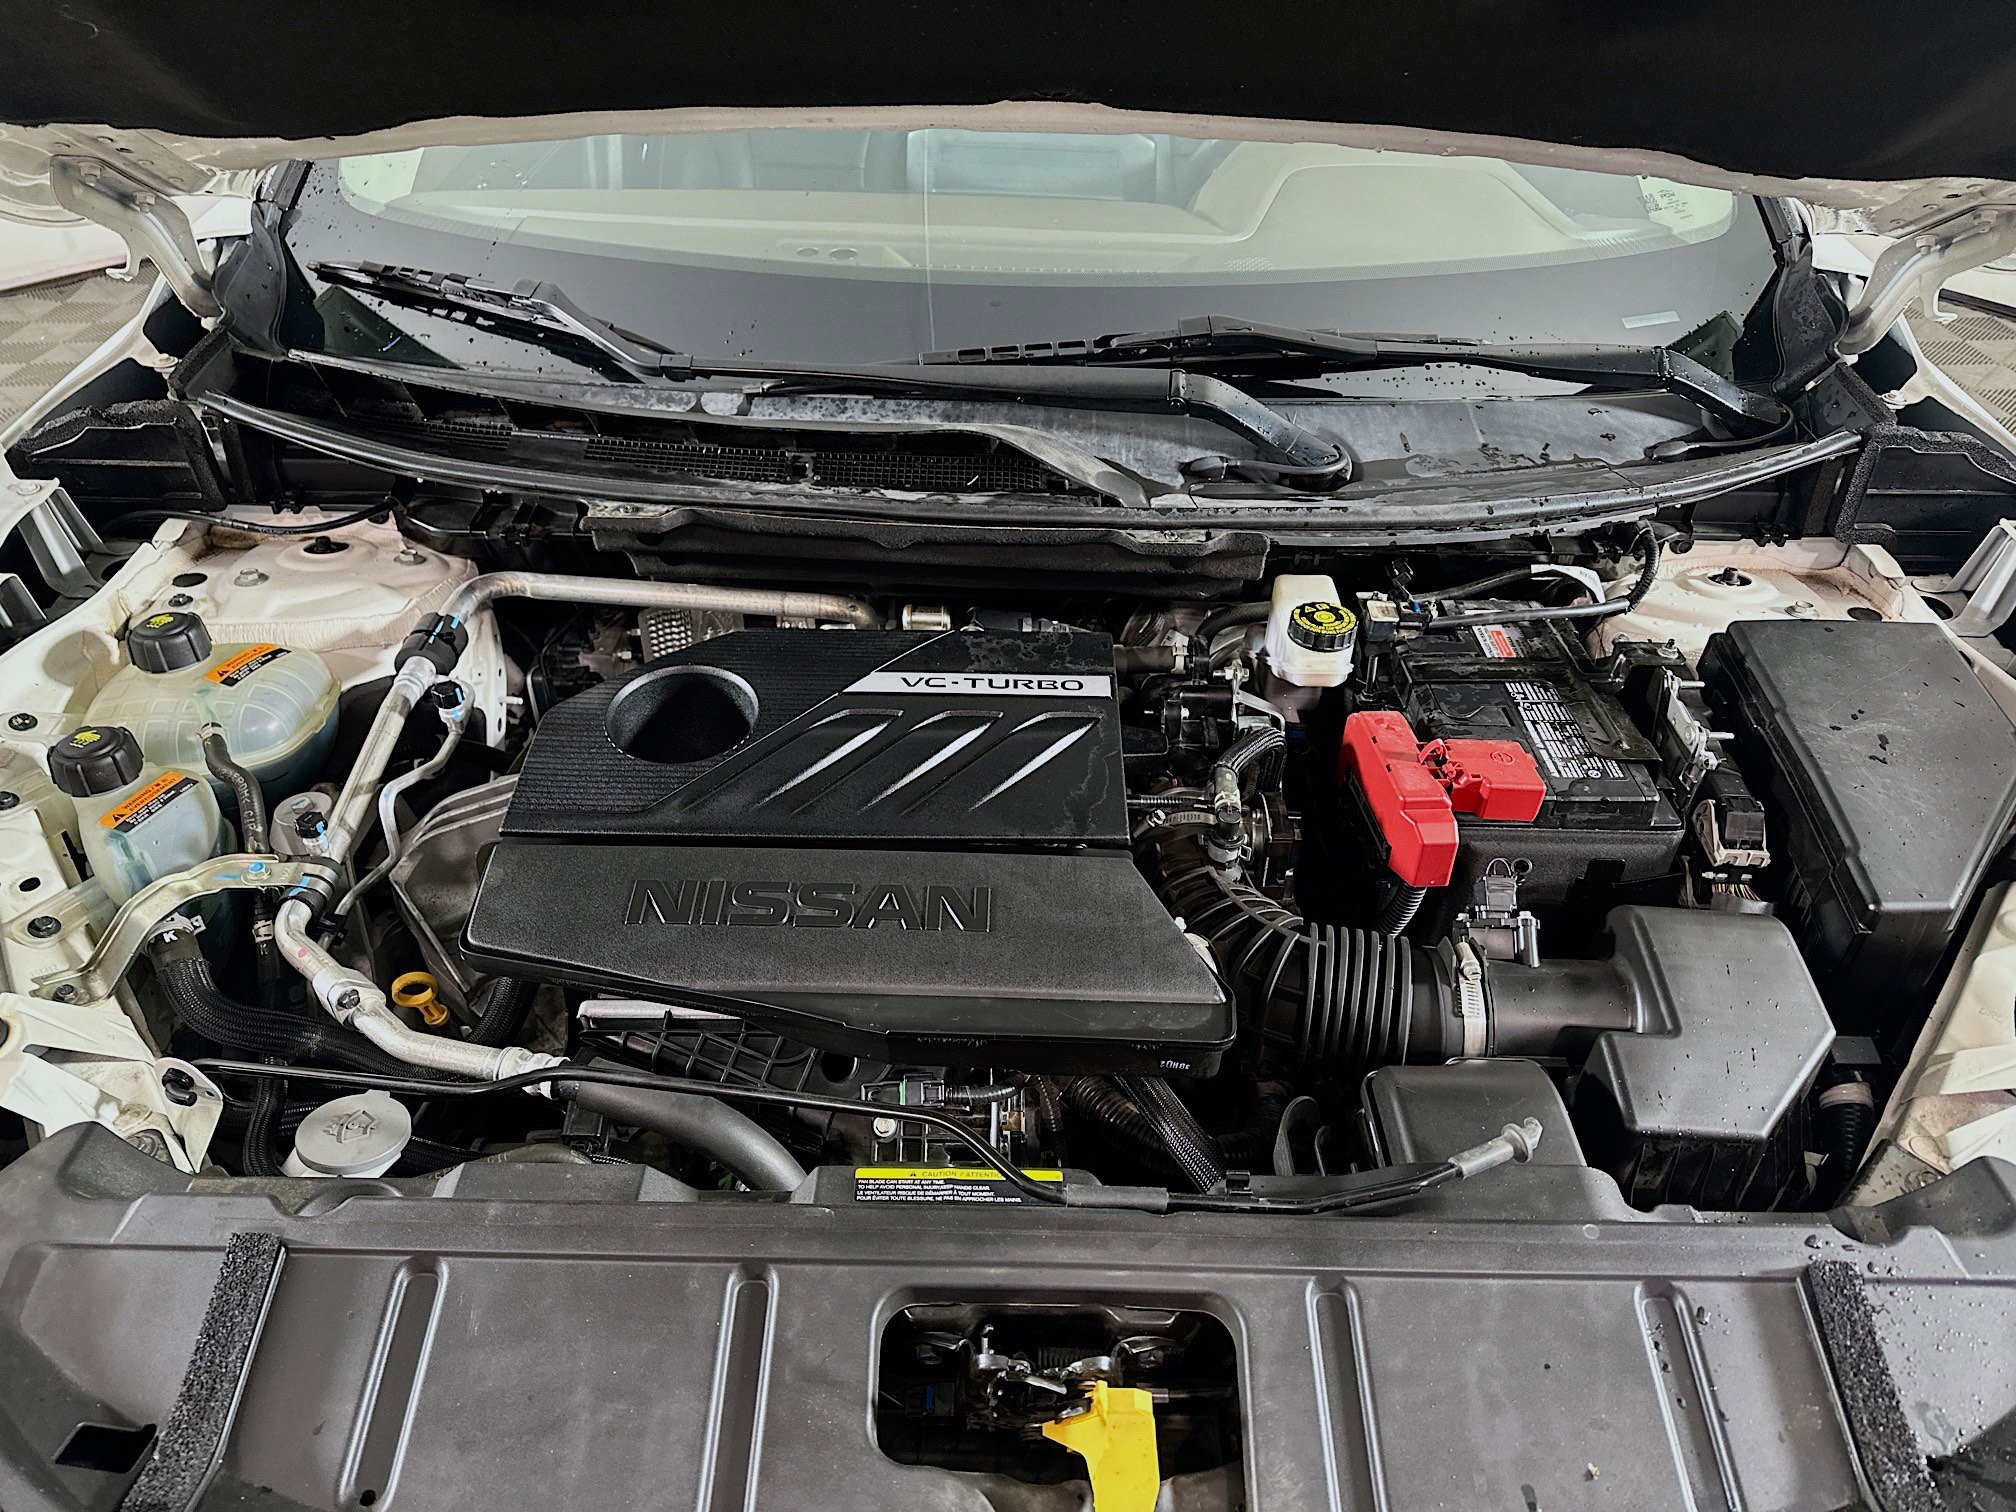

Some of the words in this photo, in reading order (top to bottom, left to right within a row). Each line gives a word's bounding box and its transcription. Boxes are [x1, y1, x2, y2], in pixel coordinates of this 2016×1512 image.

[900, 676, 1084, 691] VC-TURBO
[624, 879, 991, 933] NISSAN
[162, 930, 178, 943] K
[921, 1170, 957, 1178] CAUTION
